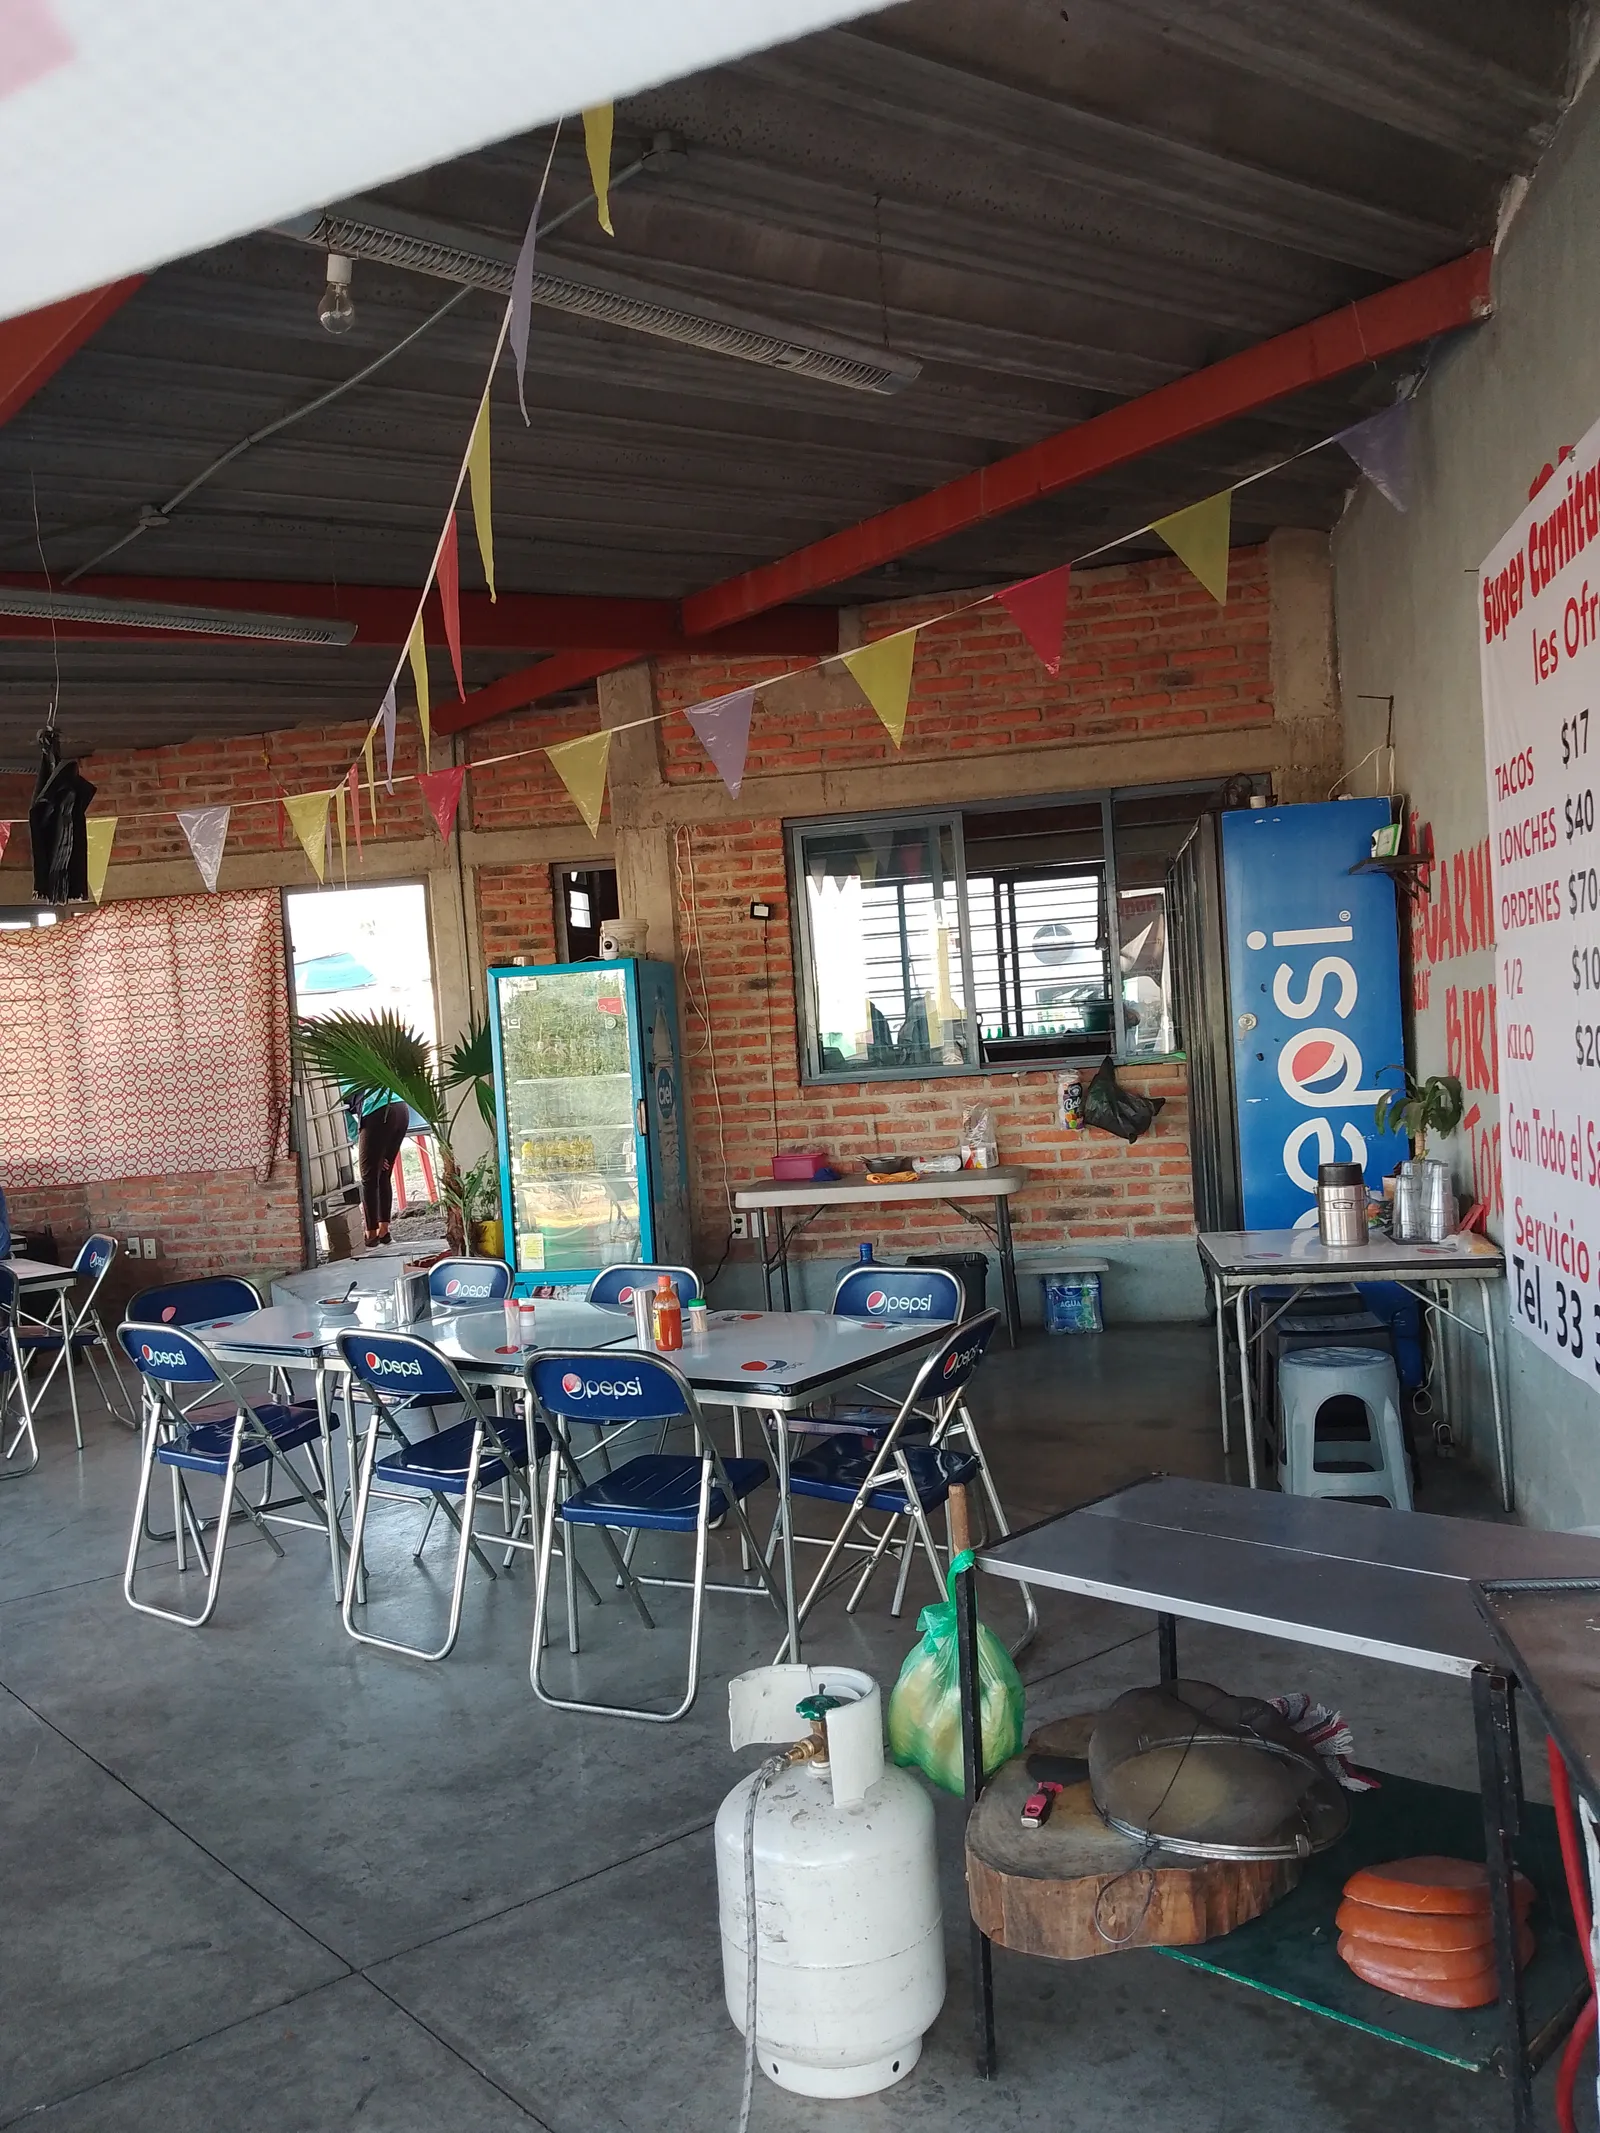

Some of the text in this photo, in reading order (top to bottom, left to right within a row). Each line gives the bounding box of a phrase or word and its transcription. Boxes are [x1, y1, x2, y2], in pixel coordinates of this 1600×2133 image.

[1483, 548, 1524, 645] Super
[1528, 455, 1600, 598] Carnita
[1533, 579, 1600, 686] les Ofr
[1561, 708, 1589, 769] $17
[1495, 746, 1534, 802] TACOS
[1499, 806, 1557, 866] LONCHES
[1565, 788, 1594, 846] $40
[1502, 879, 1561, 931] ORDENES
[1504, 957, 1523, 1000] 1/2
[1507, 1023, 1535, 1061] KILO
[1246, 926, 1393, 1230] epsi
[1509, 1102, 1531, 1163] Con
[1533, 1108, 1567, 1176] Todo
[1571, 1114, 1583, 1182] el
[1514, 1196, 1590, 1283] Servicio
[886, 1293, 933, 1314] pepsi
[1060, 1300, 1082, 1308] AGUA
[1513, 1254, 1548, 1335] Tel.
[154, 1350, 187, 1368] pepsi
[384, 1359, 423, 1378] pepsi
[585, 1376, 643, 1400] pepsi
